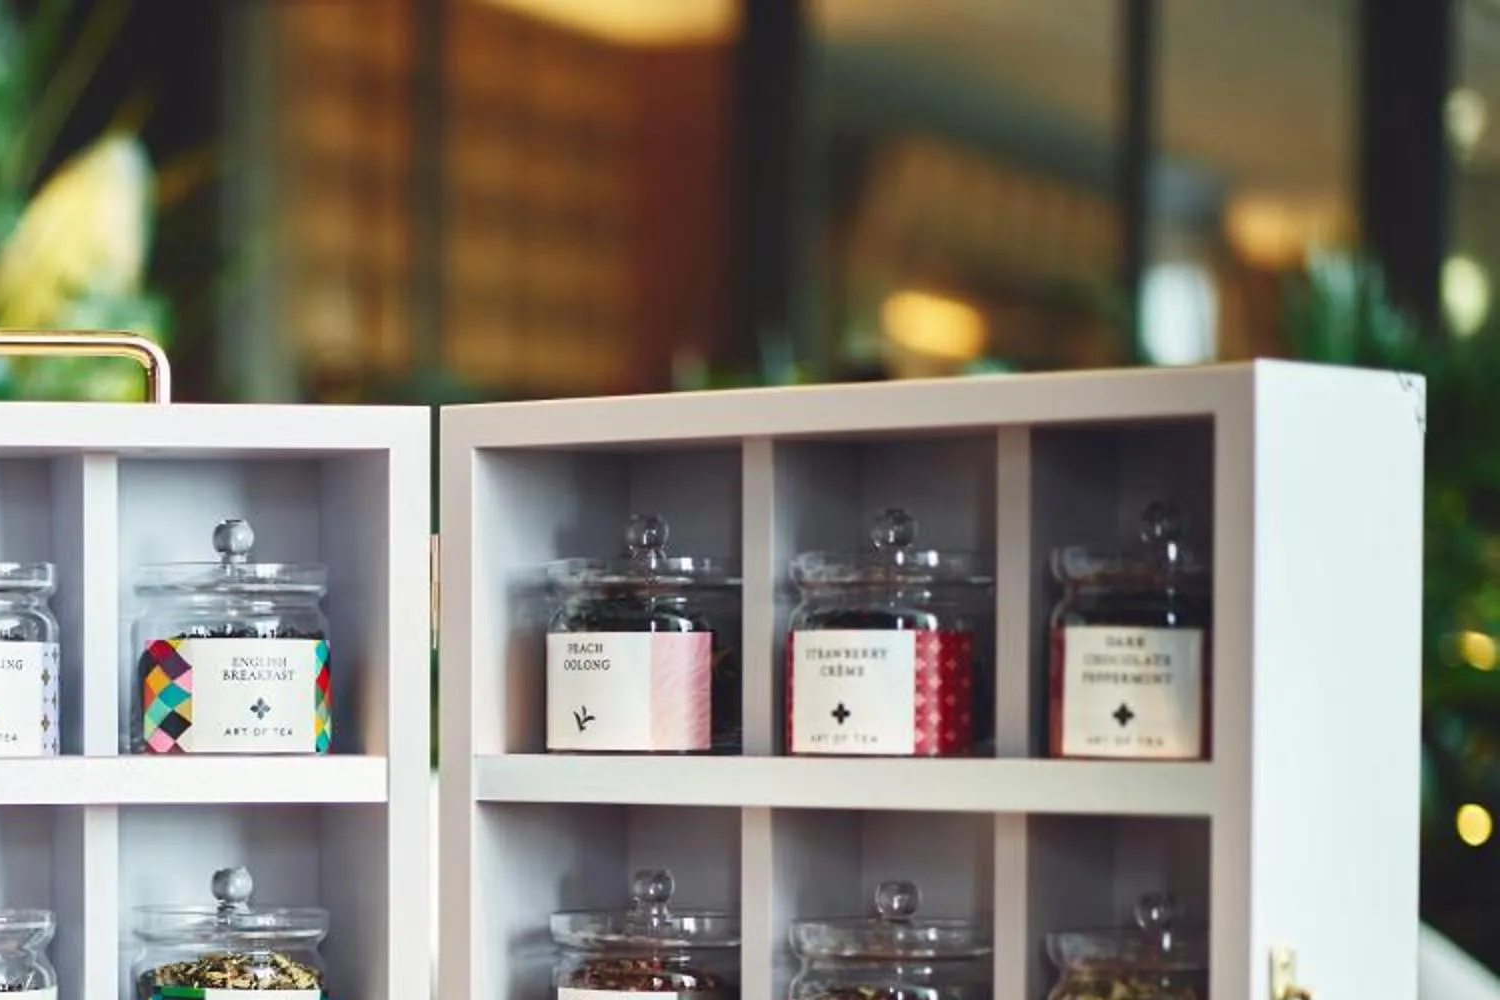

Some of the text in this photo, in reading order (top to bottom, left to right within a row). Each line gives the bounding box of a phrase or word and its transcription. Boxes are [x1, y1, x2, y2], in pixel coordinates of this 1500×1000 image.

[567, 643, 603, 654] PEACH
[806, 648, 888, 661] STRAWBERRY
[231, 657, 287, 668] ENGLISH
[564, 659, 611, 671] OOLONG
[223, 669, 295, 681] BREAKFAST
[0, 733, 17, 742] TEA
[224, 728, 293, 736] ART OF TEA
